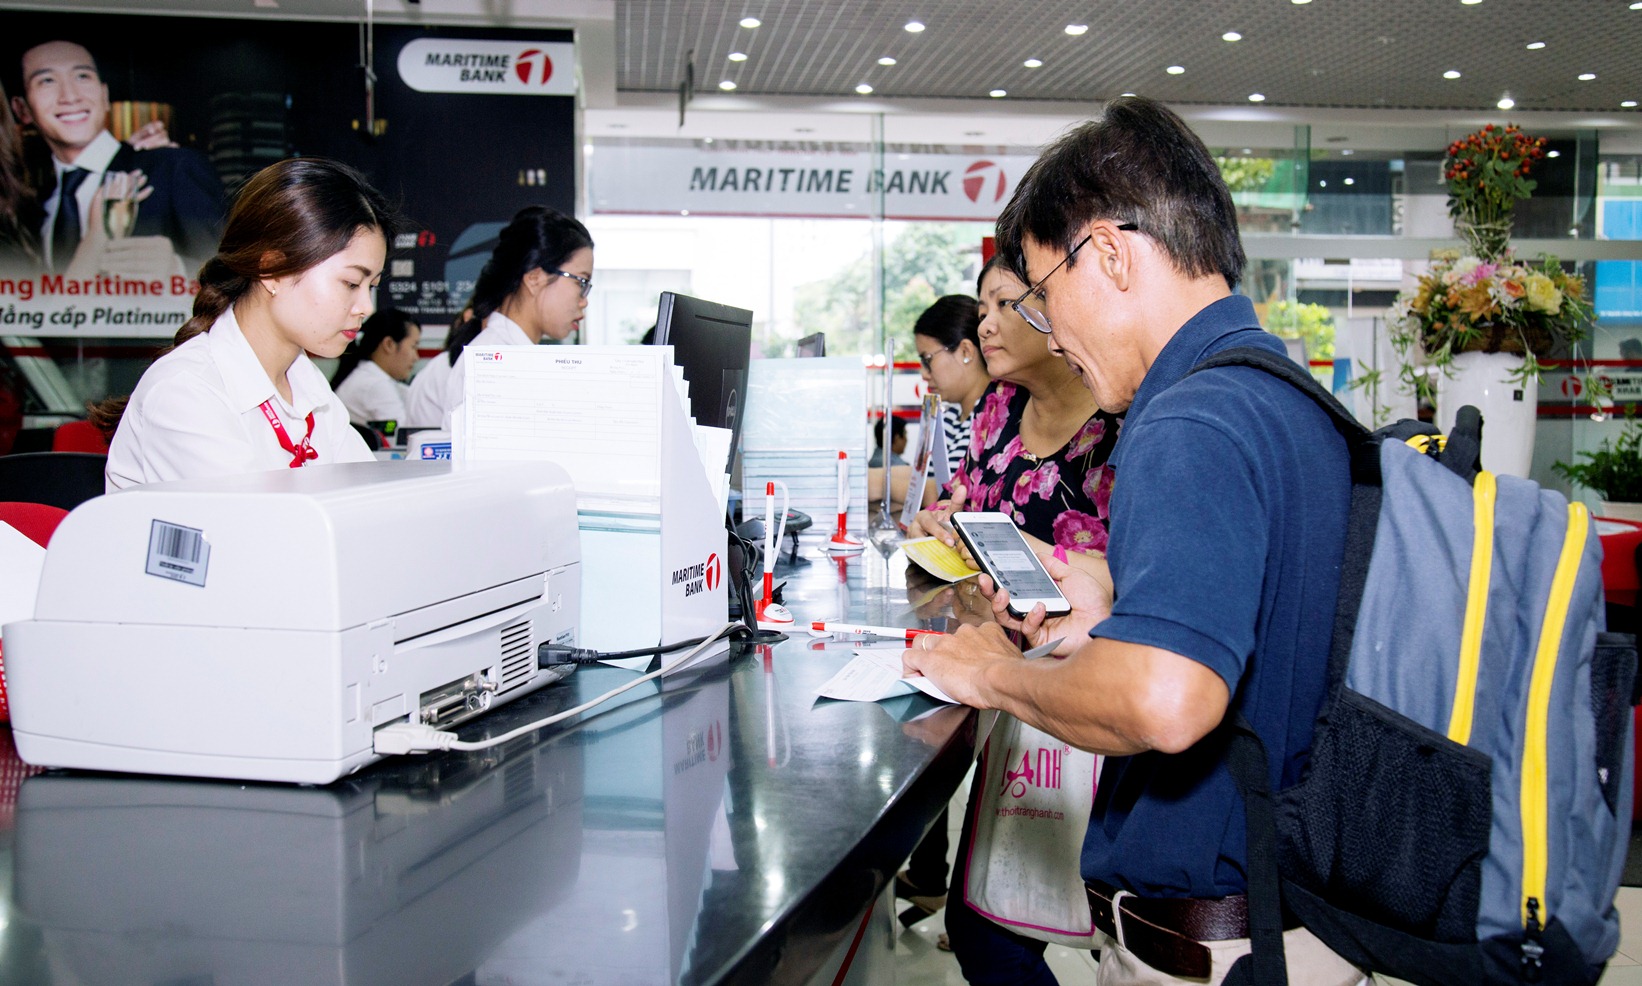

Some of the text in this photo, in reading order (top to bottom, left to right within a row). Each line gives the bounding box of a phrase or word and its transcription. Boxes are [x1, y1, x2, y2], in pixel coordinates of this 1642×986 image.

[425, 53, 510, 67] MARITIME
[460, 69, 505, 82] BANK
[689, 167, 952, 194] MARITIME BANK
[41, 275, 163, 296] Maritime
[0, 304, 186, 328] ẳng cấp Platinum
[672, 562, 704, 585] MARITIME
[685, 579, 703, 597] BANK
